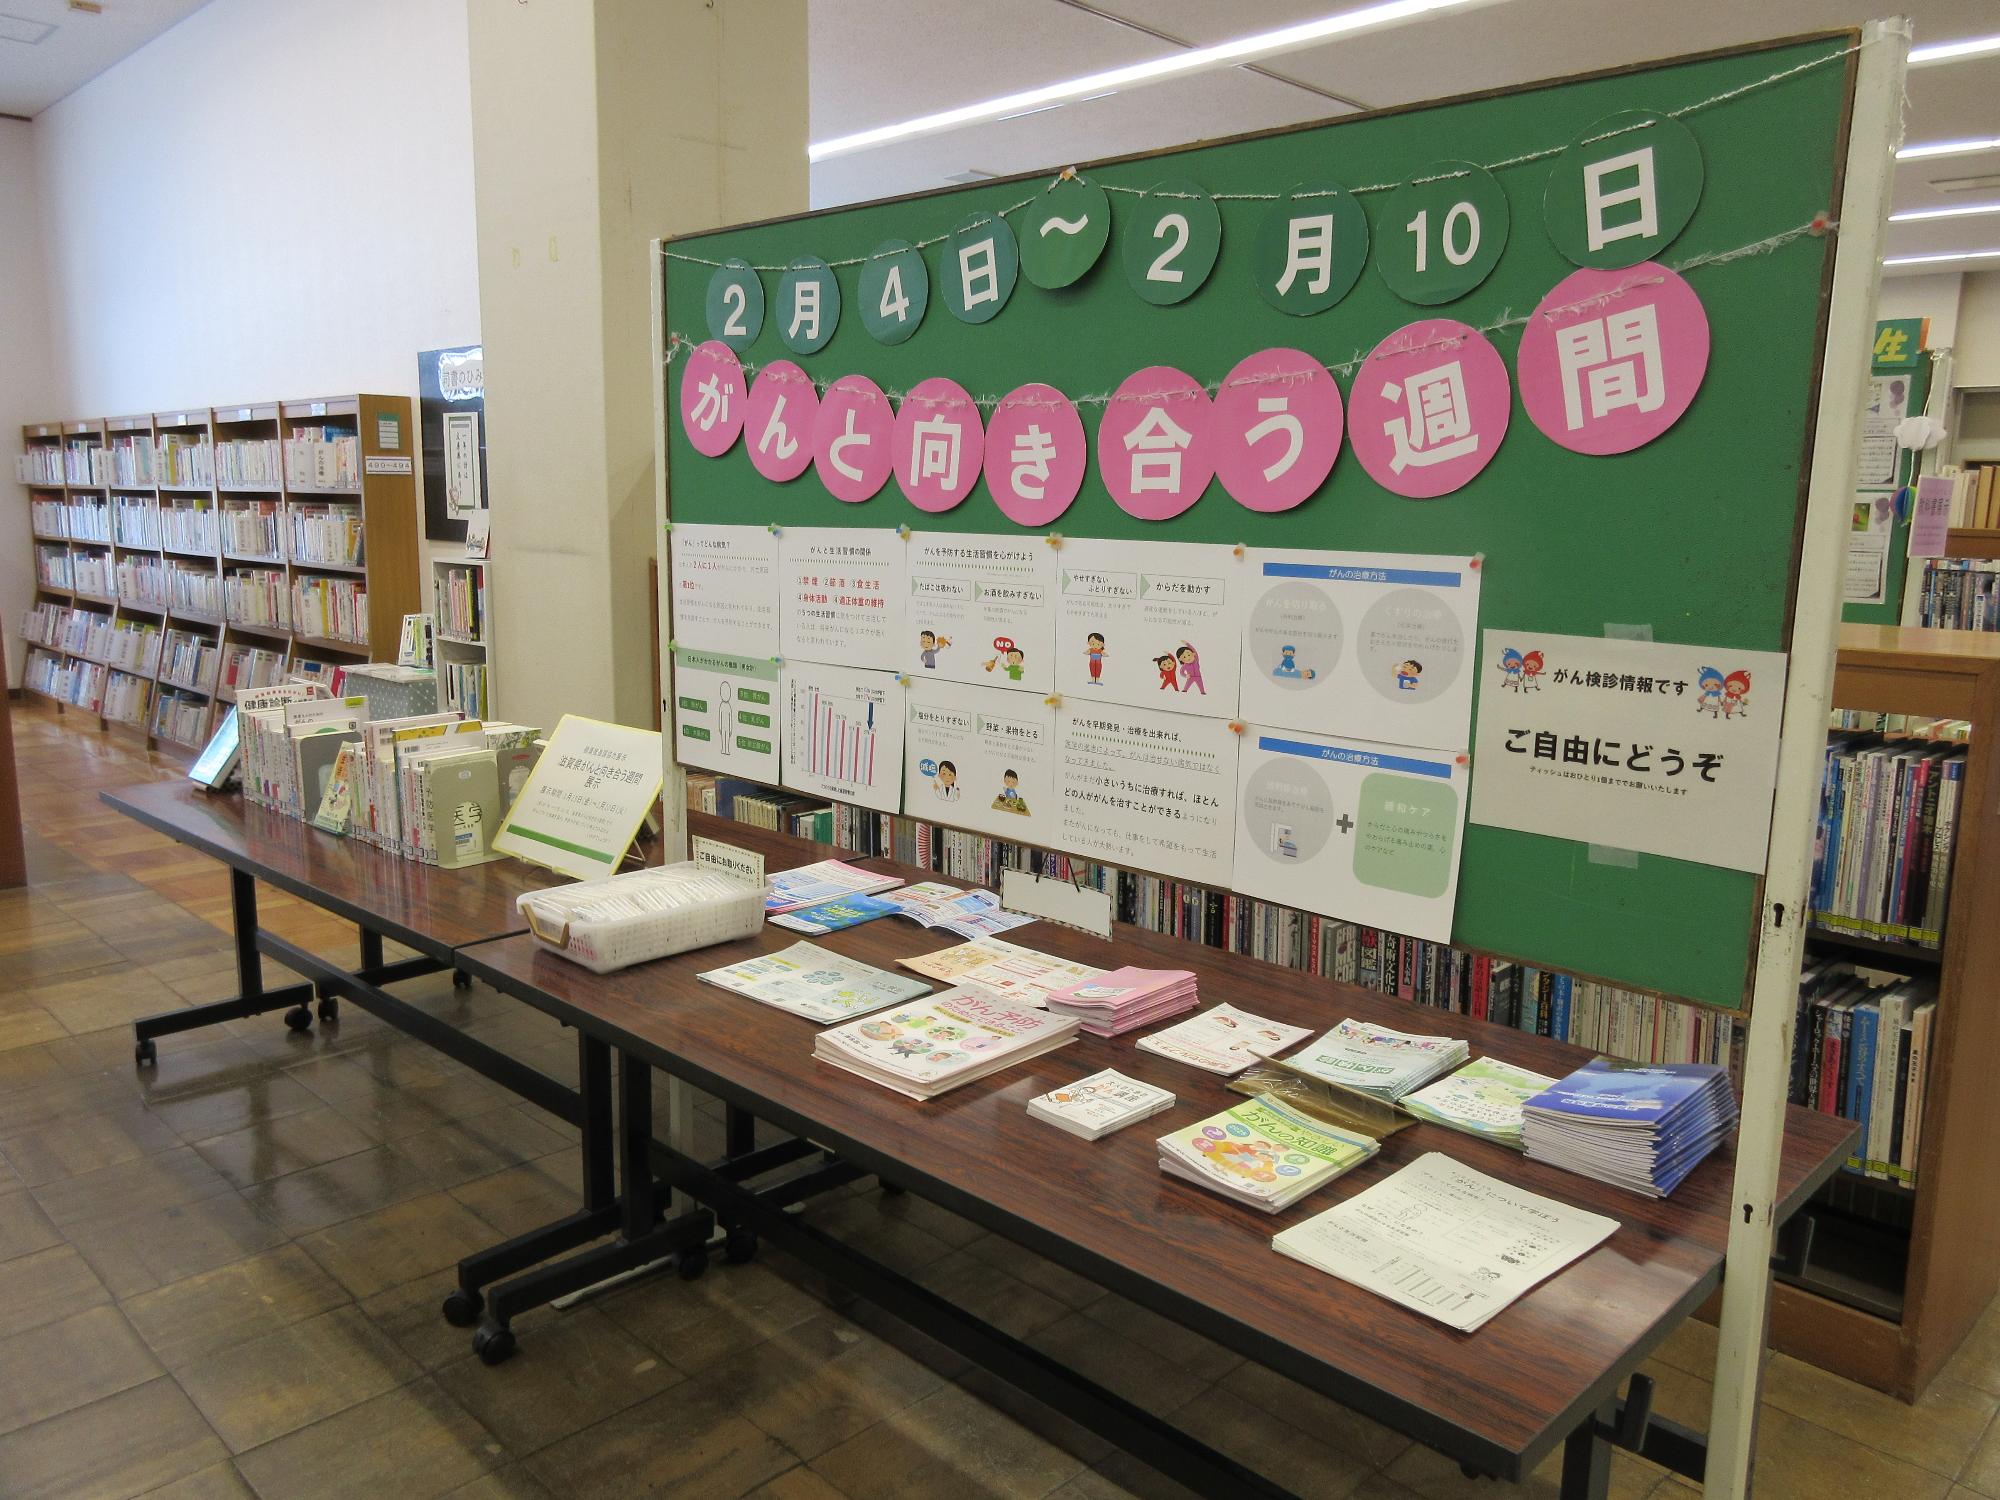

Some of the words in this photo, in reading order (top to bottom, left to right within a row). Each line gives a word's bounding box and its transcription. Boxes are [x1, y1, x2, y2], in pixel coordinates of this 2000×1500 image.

[924, 546, 1034, 562] がんを予防する生活習慣を心がけよう
[1073, 574, 1109, 584] やせすぎない
[1328, 568, 1388, 582] がんの治療方法
[919, 582, 964, 595] たばこは吸わない
[984, 588, 1042, 601] お酒を飲みすぎない
[1088, 585, 1133, 596] ふとりすぎない
[1155, 581, 1212, 595] からだを動かす
[995, 640, 1012, 648] NO
[1553, 668, 1690, 696] がん検診情報です
[985, 721, 1039, 739] 野菜・果物をとる
[1320, 749, 1380, 766] がんの治療方法
[1504, 728, 1725, 783] ご自由にどうぞ
[699, 851, 756, 875] ご自由にお取りください
[951, 995, 1046, 1030] がん予防
[1241, 1110, 1339, 1157] がんの知識
